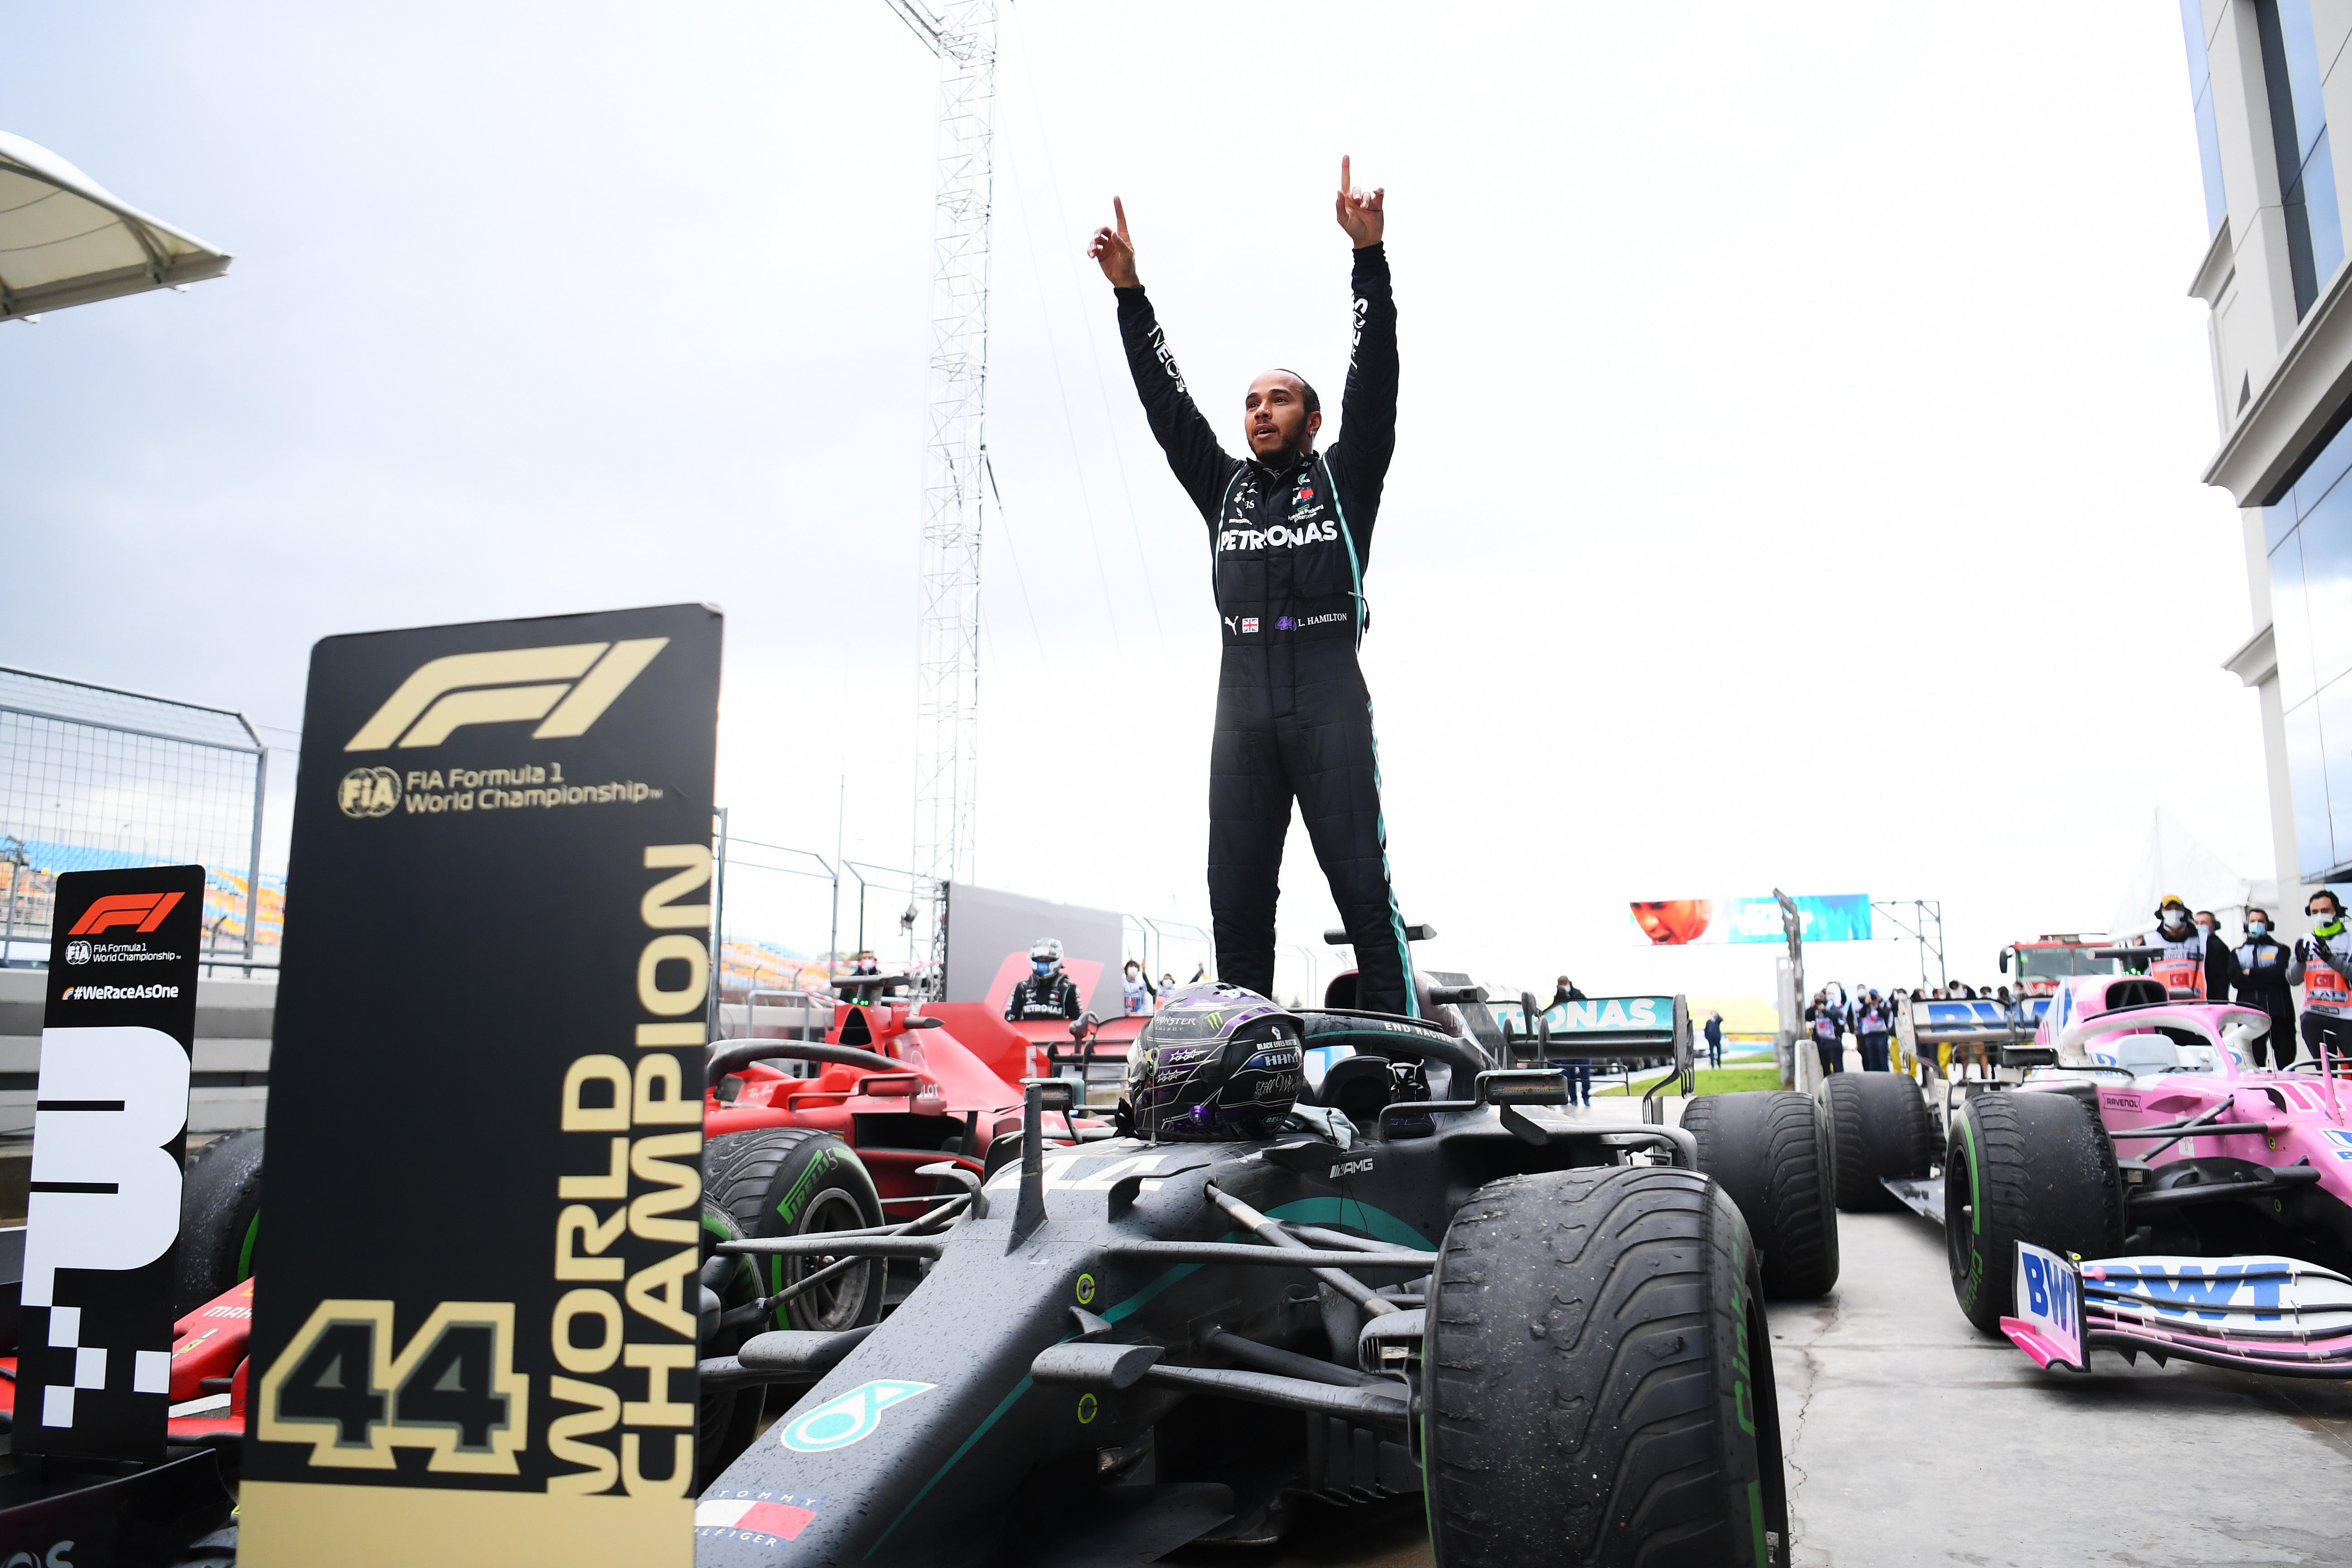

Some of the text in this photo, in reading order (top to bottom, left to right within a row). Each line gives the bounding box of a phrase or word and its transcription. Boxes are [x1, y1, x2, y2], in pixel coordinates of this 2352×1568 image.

[1220, 520, 1338, 552] PETRONAS
[1298, 619, 1305, 627] L.
[1307, 613, 1347, 625] HAMILTON
[406, 762, 565, 790] FIA Formula 1
[405, 788, 474, 814] World
[94, 944, 107, 953] FIA
[108, 943, 141, 952] Formula
[93, 953, 117, 963] World
[73, 984, 179, 1000] #WeRaceAsOne
[1384, 1021, 1411, 1033] END
[1256, 1041, 1274, 1050] BLACK
[2107, 1097, 2138, 1108] RAVENOL
[620, 843, 714, 1499] CHAMPION
[1343, 1158, 1374, 1176] AMG
[546, 1054, 632, 1496] WORLD
[2022, 1251, 2077, 1341] BWT
[2084, 1263, 2292, 1322] BWT
[257, 1298, 530, 1476] 44
[719, 1490, 816, 1507] TOMMY
